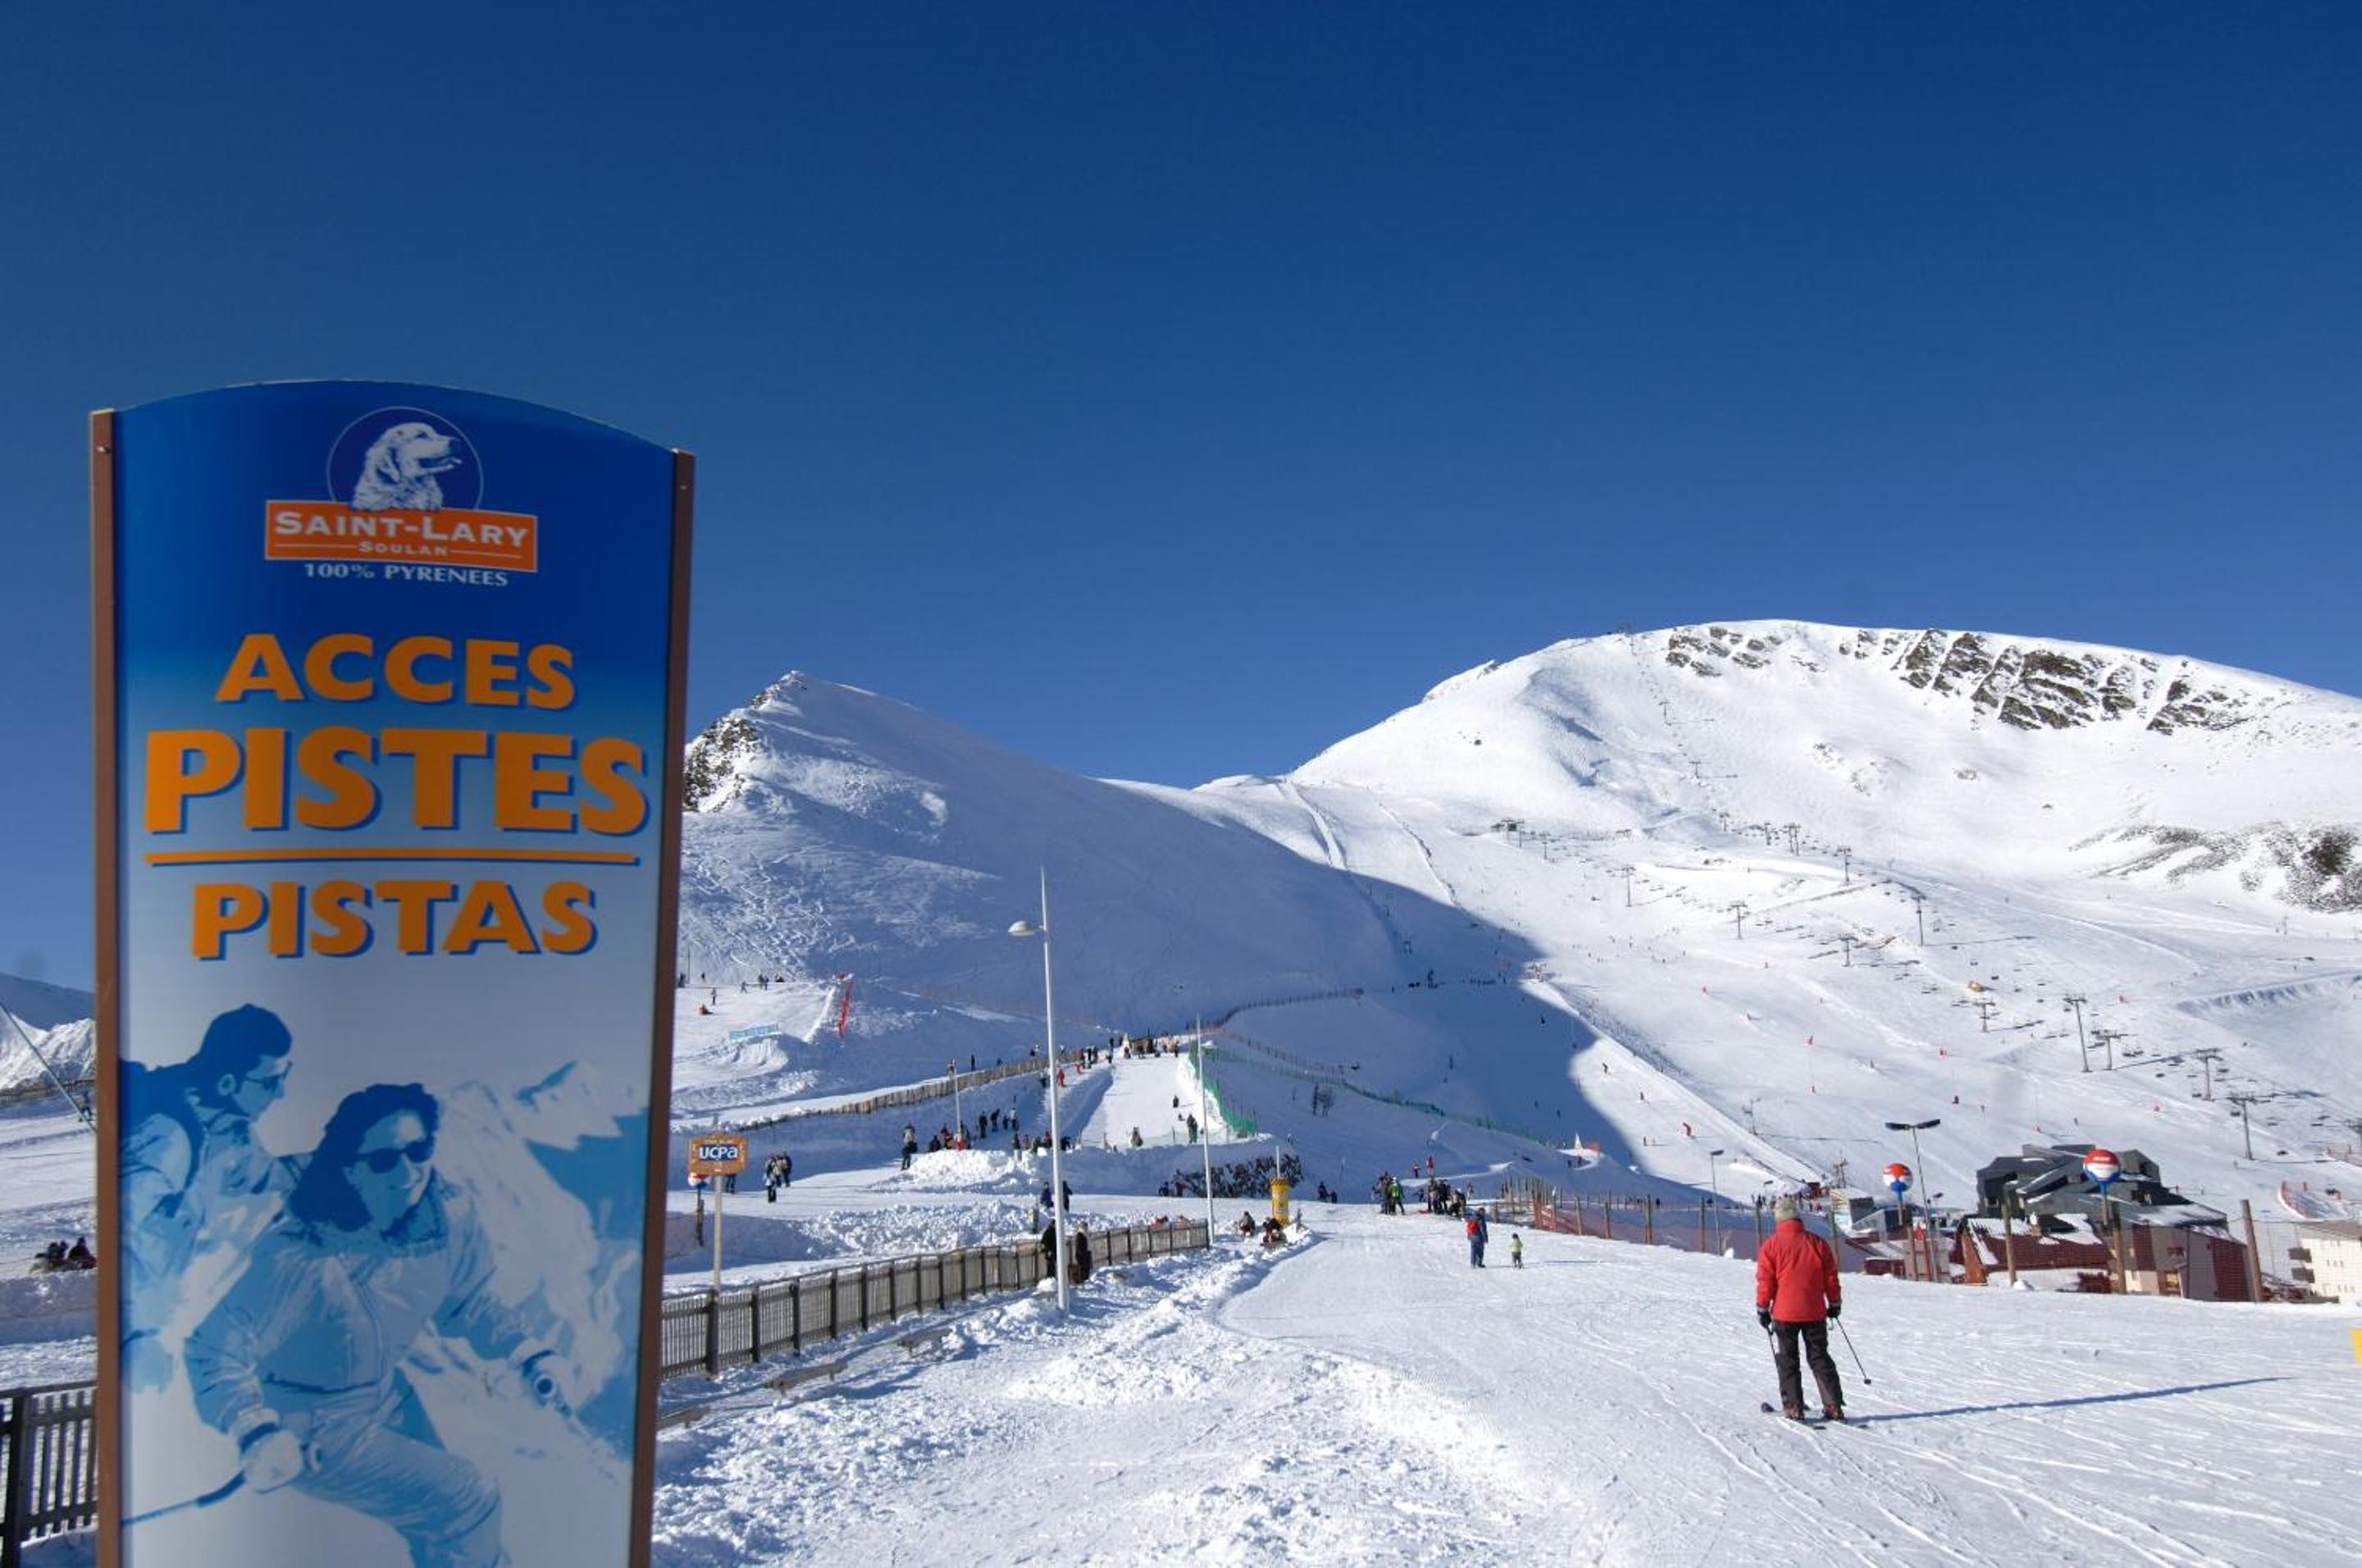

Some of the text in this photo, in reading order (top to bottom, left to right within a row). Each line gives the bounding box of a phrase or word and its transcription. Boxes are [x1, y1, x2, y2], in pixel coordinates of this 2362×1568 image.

[276, 511, 529, 547] SAINT-LARY
[359, 541, 449, 556] SOULAN
[304, 563, 509, 586] 100% PYRENEES
[215, 633, 577, 710] ACCES
[145, 727, 650, 836] PISTES
[192, 880, 599, 960] PISTAS
